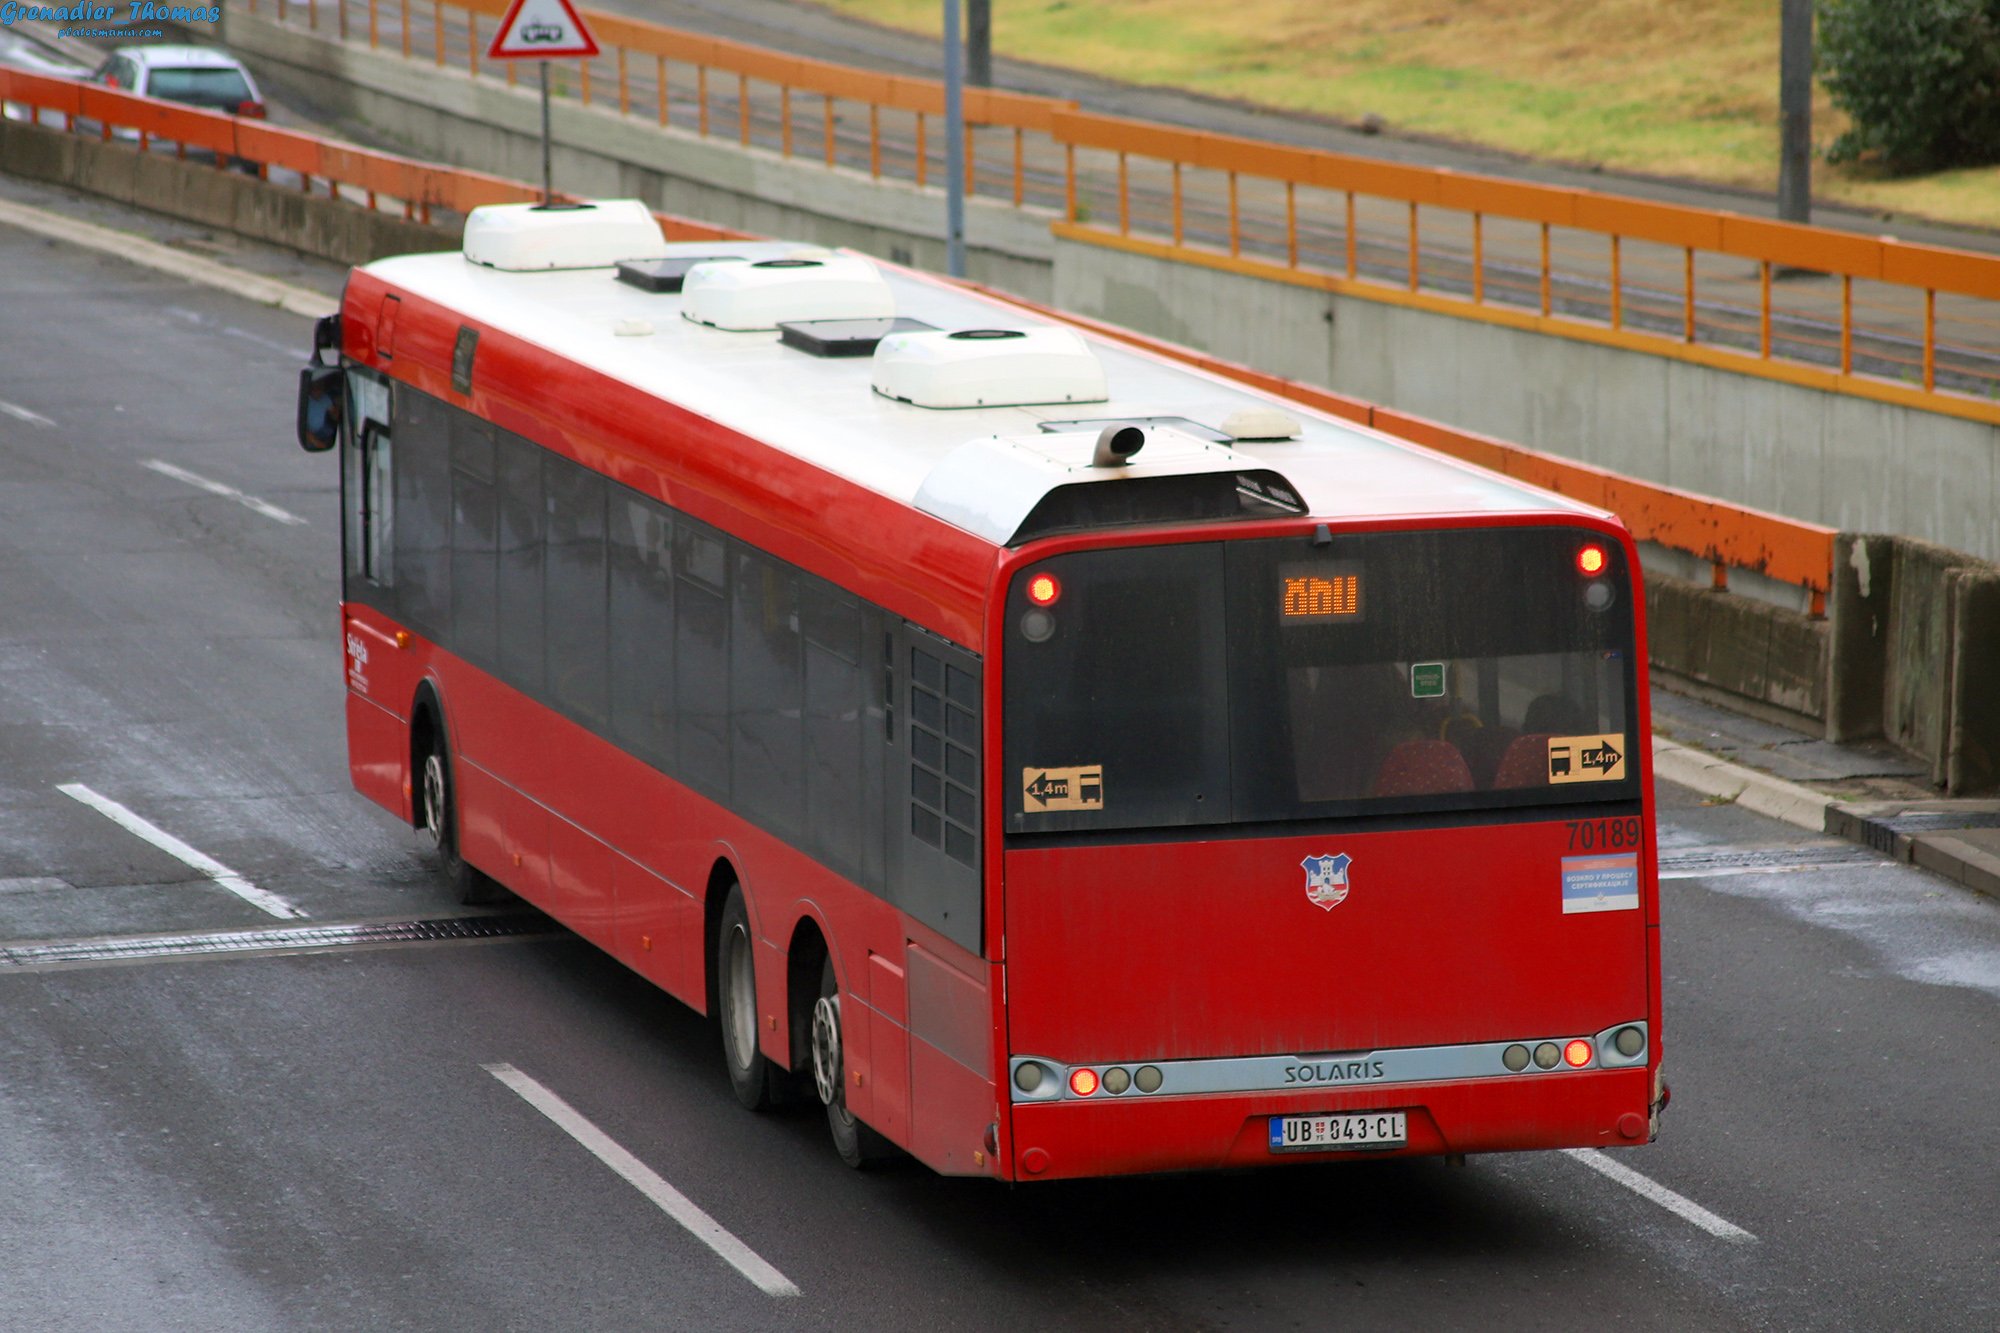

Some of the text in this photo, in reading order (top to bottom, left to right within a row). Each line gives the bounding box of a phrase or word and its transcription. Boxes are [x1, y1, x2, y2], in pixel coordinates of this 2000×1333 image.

[1566, 818, 1640, 850] 70189
[1566, 874, 1594, 883] ВОЗИЛО
[1601, 871, 1634, 881] ПРОЦЕСУ
[1285, 1061, 1384, 1083] SOLARIS
[1287, 1120, 1311, 1142] UB
